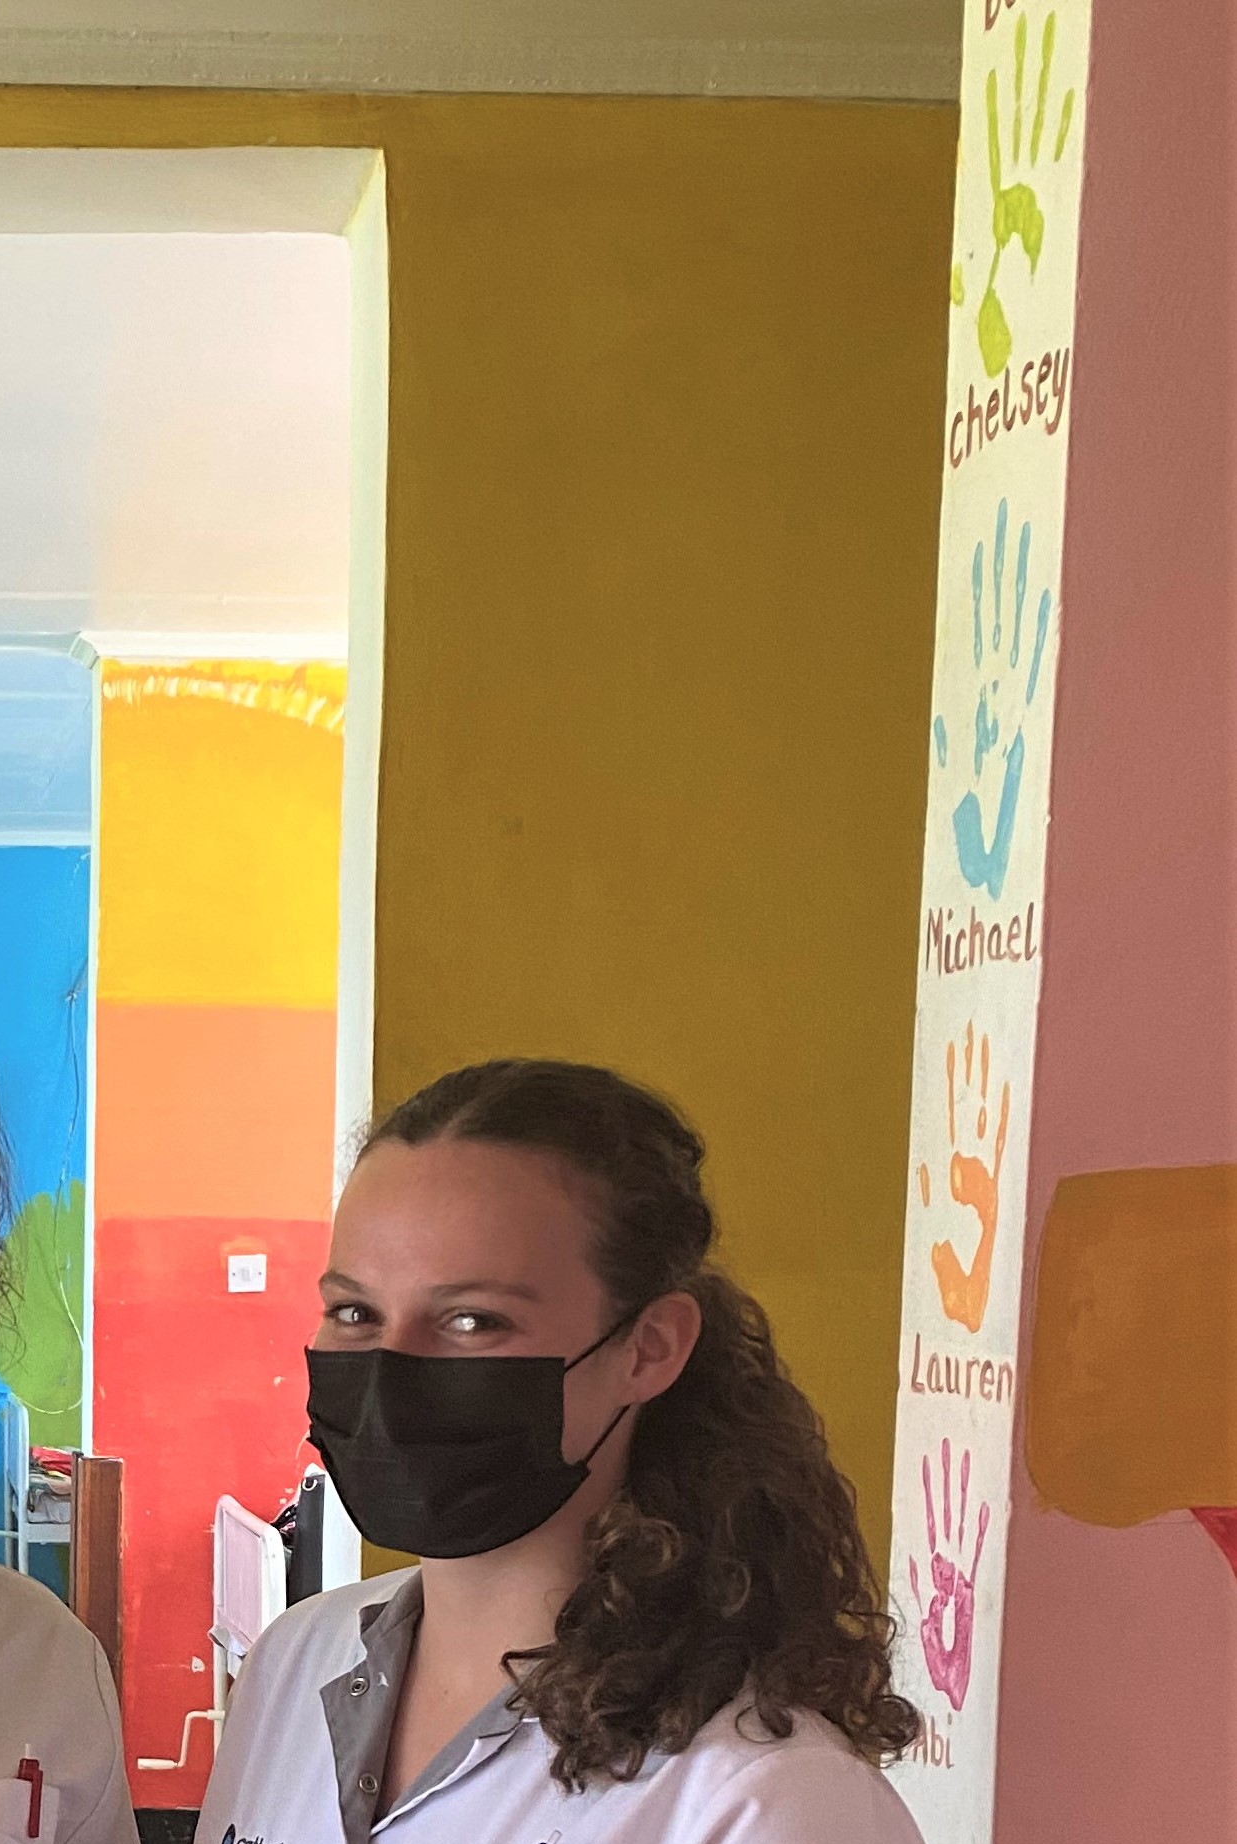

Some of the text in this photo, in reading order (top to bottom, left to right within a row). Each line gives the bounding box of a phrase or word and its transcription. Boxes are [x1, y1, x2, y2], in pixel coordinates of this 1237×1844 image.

[949, 346, 1070, 469] chelsey
[925, 902, 1037, 977] Michael
[910, 1331, 1013, 1405] Lauren
